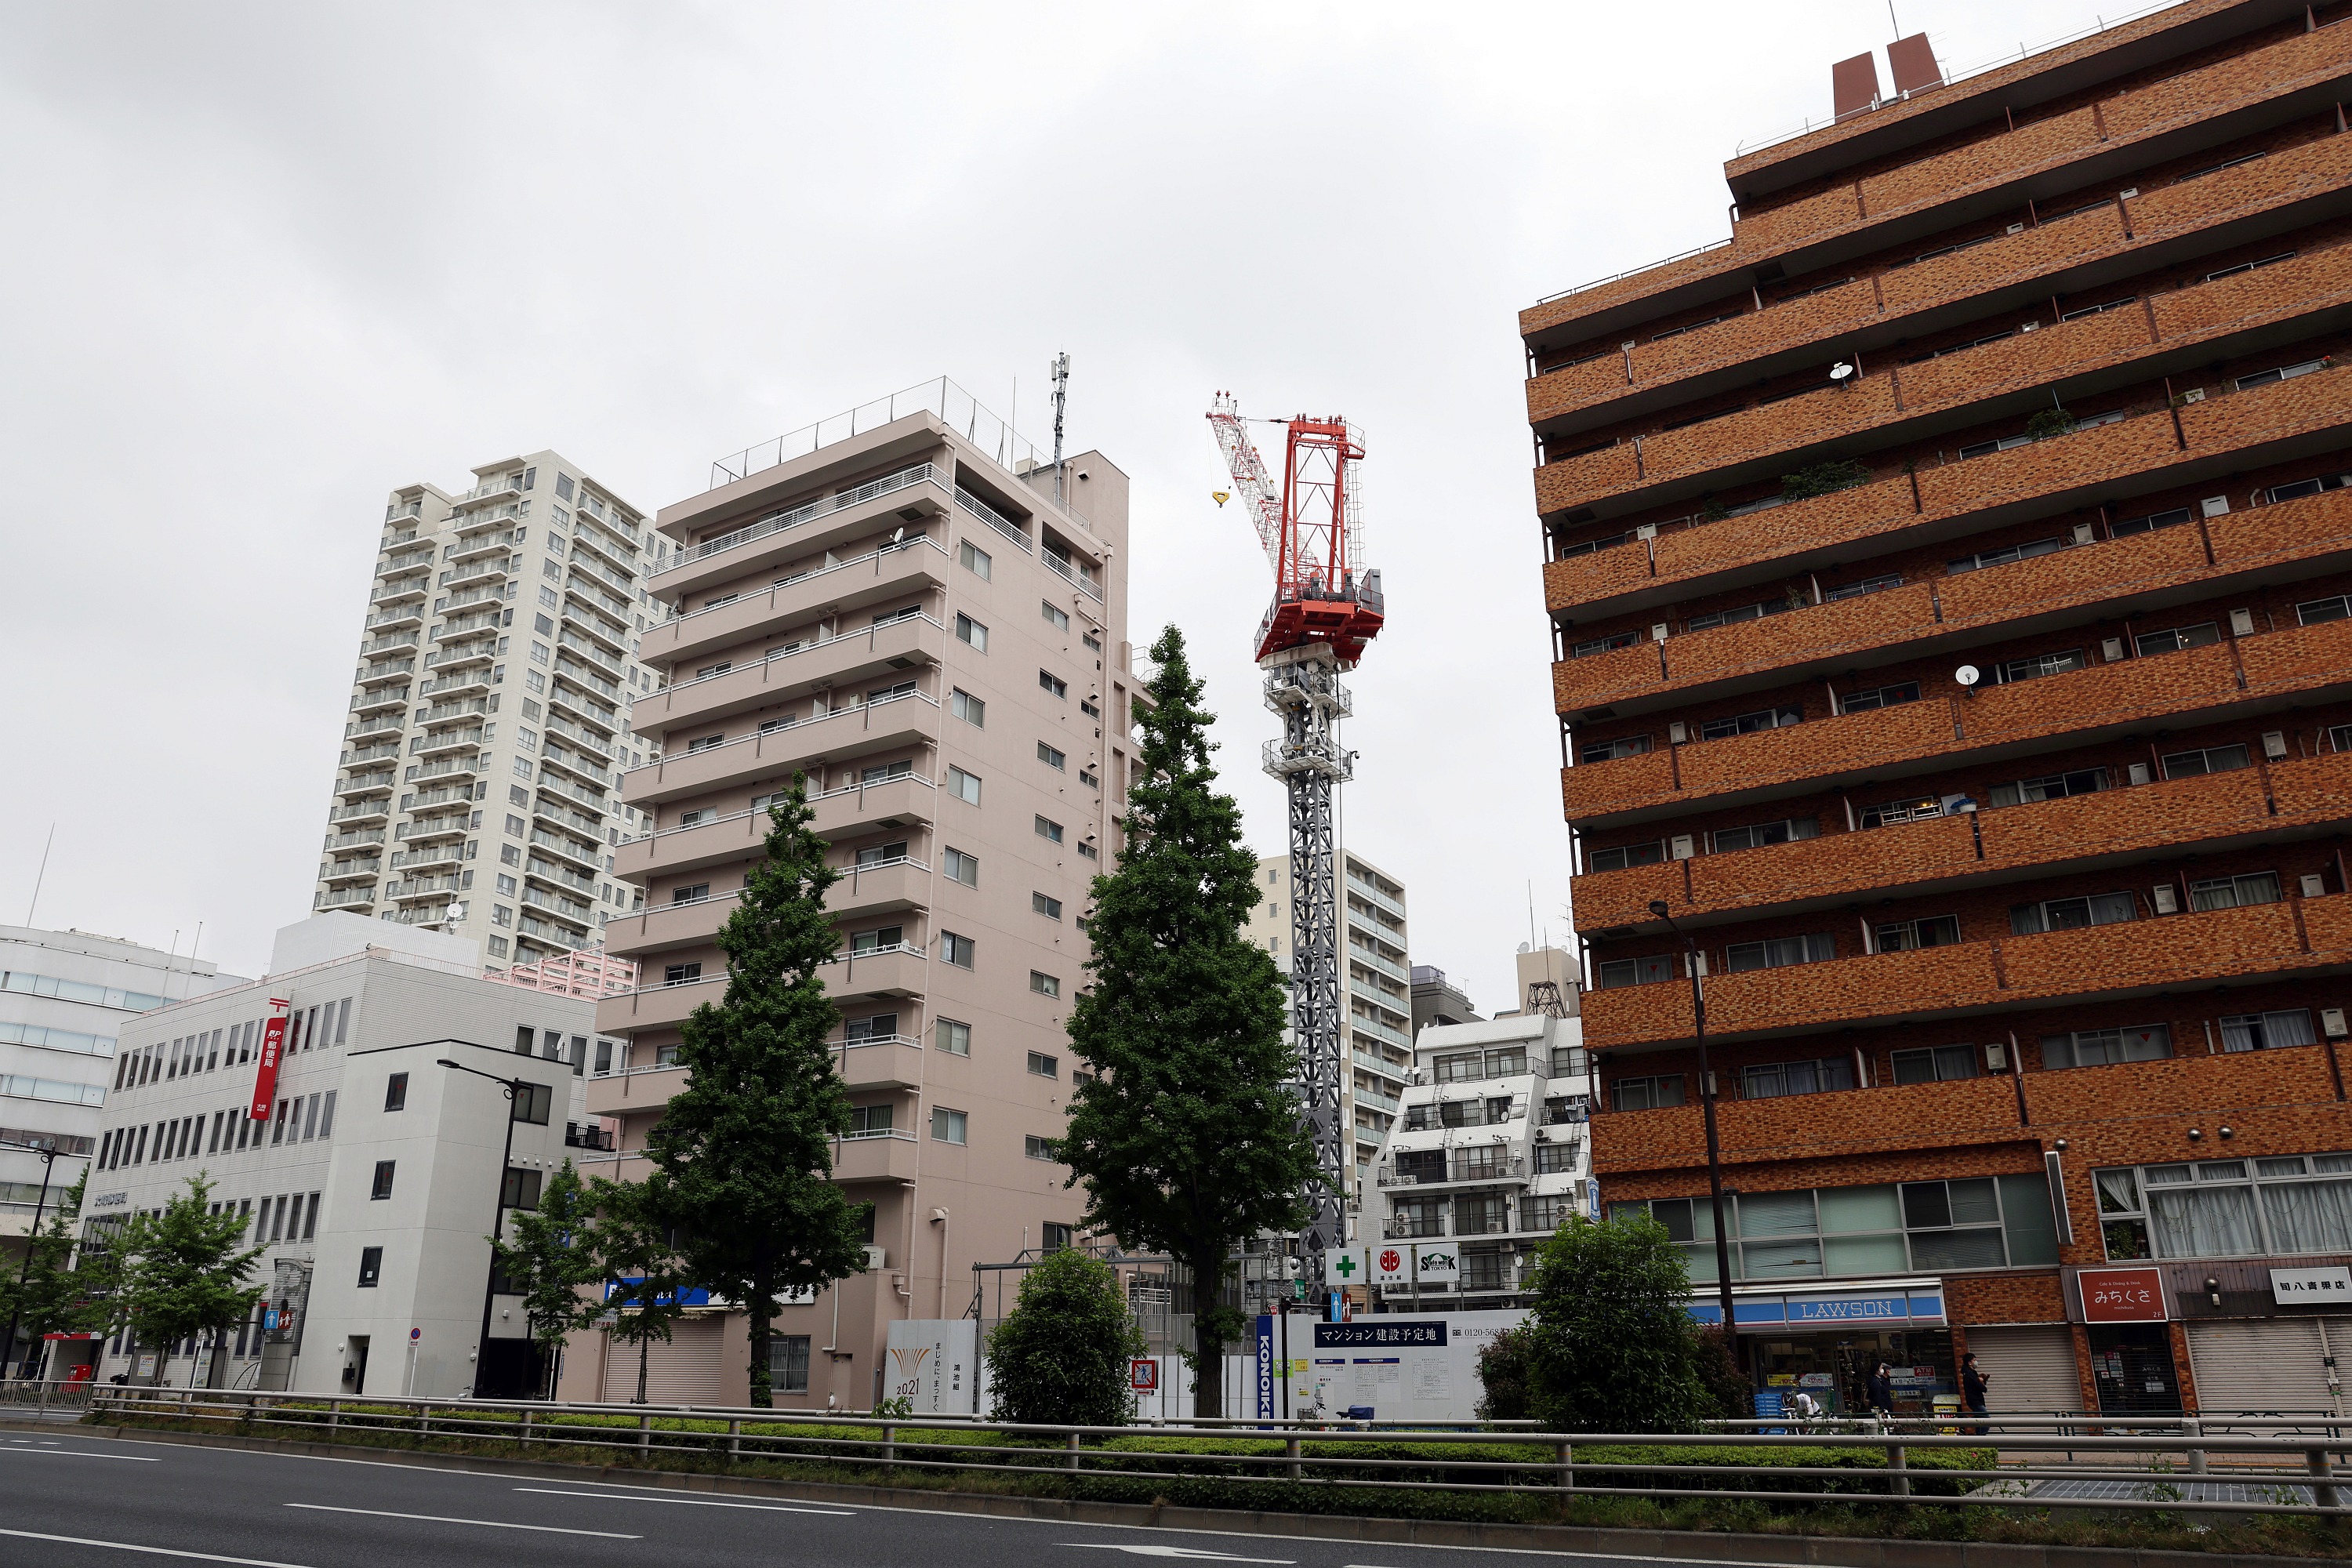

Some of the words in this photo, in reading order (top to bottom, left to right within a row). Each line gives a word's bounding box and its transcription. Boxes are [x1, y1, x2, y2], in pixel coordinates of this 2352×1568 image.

[263, 1041, 277, 1068] 郵便局
[2280, 1280, 2346, 1291] 旬八青果店
[2094, 1289, 2151, 1304] みちくさ
[1801, 1301, 1893, 1318] LAWSON
[1322, 1327, 1437, 1341] マンション建設予定地
[896, 1377, 920, 1395] 2021
[933, 1342, 942, 1412] まじめに、まっすぐ
[952, 1363, 960, 1391] 鴻池組
[1260, 1335, 1270, 1420] KONOIKE
